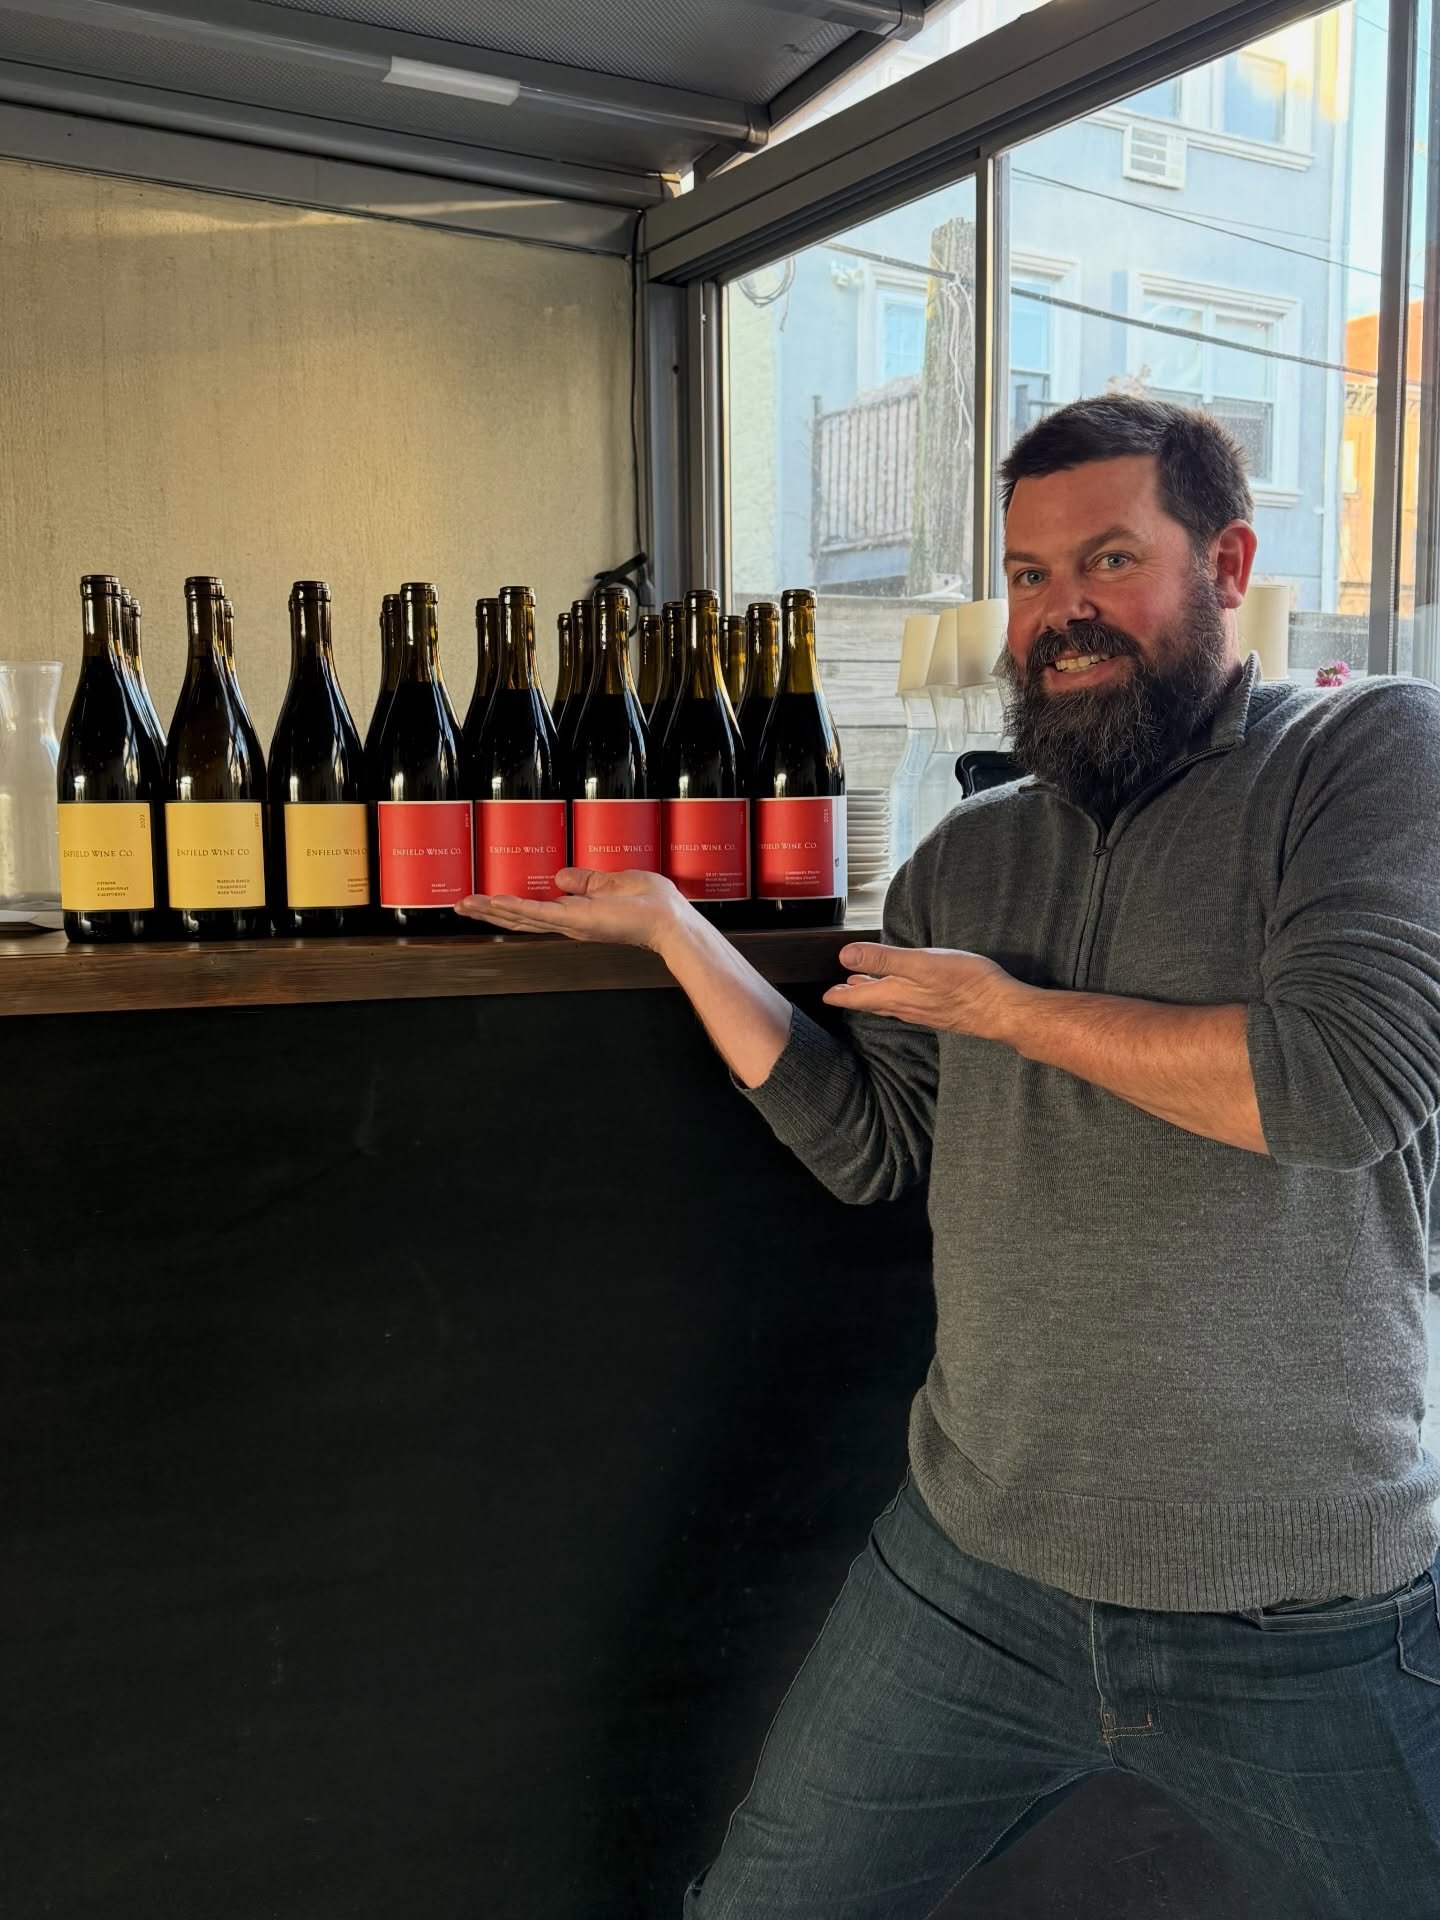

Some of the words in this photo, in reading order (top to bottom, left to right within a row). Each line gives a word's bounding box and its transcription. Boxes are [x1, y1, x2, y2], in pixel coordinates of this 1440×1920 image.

[489, 846, 521, 854] ENFIELD
[588, 845, 621, 853] ENFIELD
[670, 843, 700, 851] ENFIELD
[701, 843, 722, 851] WINE
[63, 849, 90, 858] ENFIELD
[91, 849, 116, 858] WINE
[176, 848, 209, 857] ENFIELD
[211, 848, 235, 856] WINE
[306, 848, 341, 856] ENFIELD
[343, 848, 361, 856] WINE
[392, 848, 425, 856] ENFIELD
[426, 848, 449, 856] WINE
